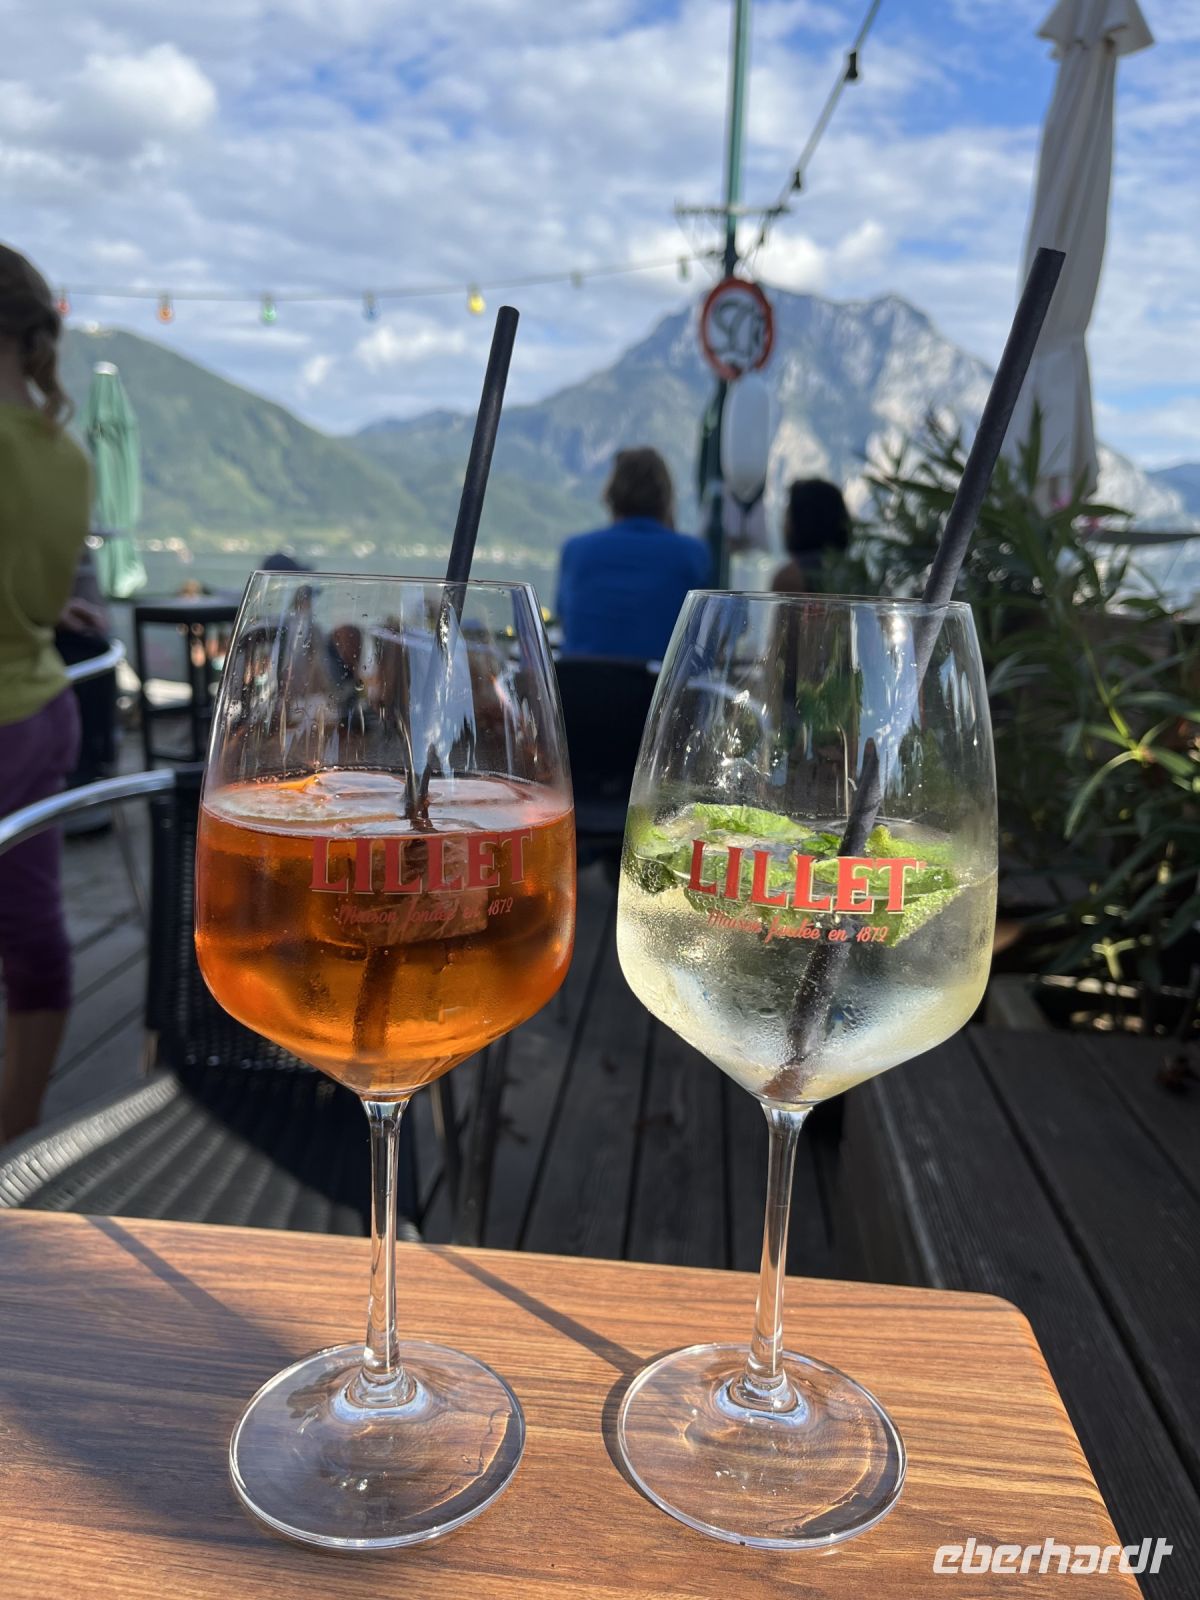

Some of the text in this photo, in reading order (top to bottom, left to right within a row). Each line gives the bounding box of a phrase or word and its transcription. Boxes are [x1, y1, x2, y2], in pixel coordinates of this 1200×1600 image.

[309, 828, 533, 894] LILLET
[687, 839, 919, 915] LILLET
[827, 928, 848, 942] en
[855, 925, 889, 943] 1872
